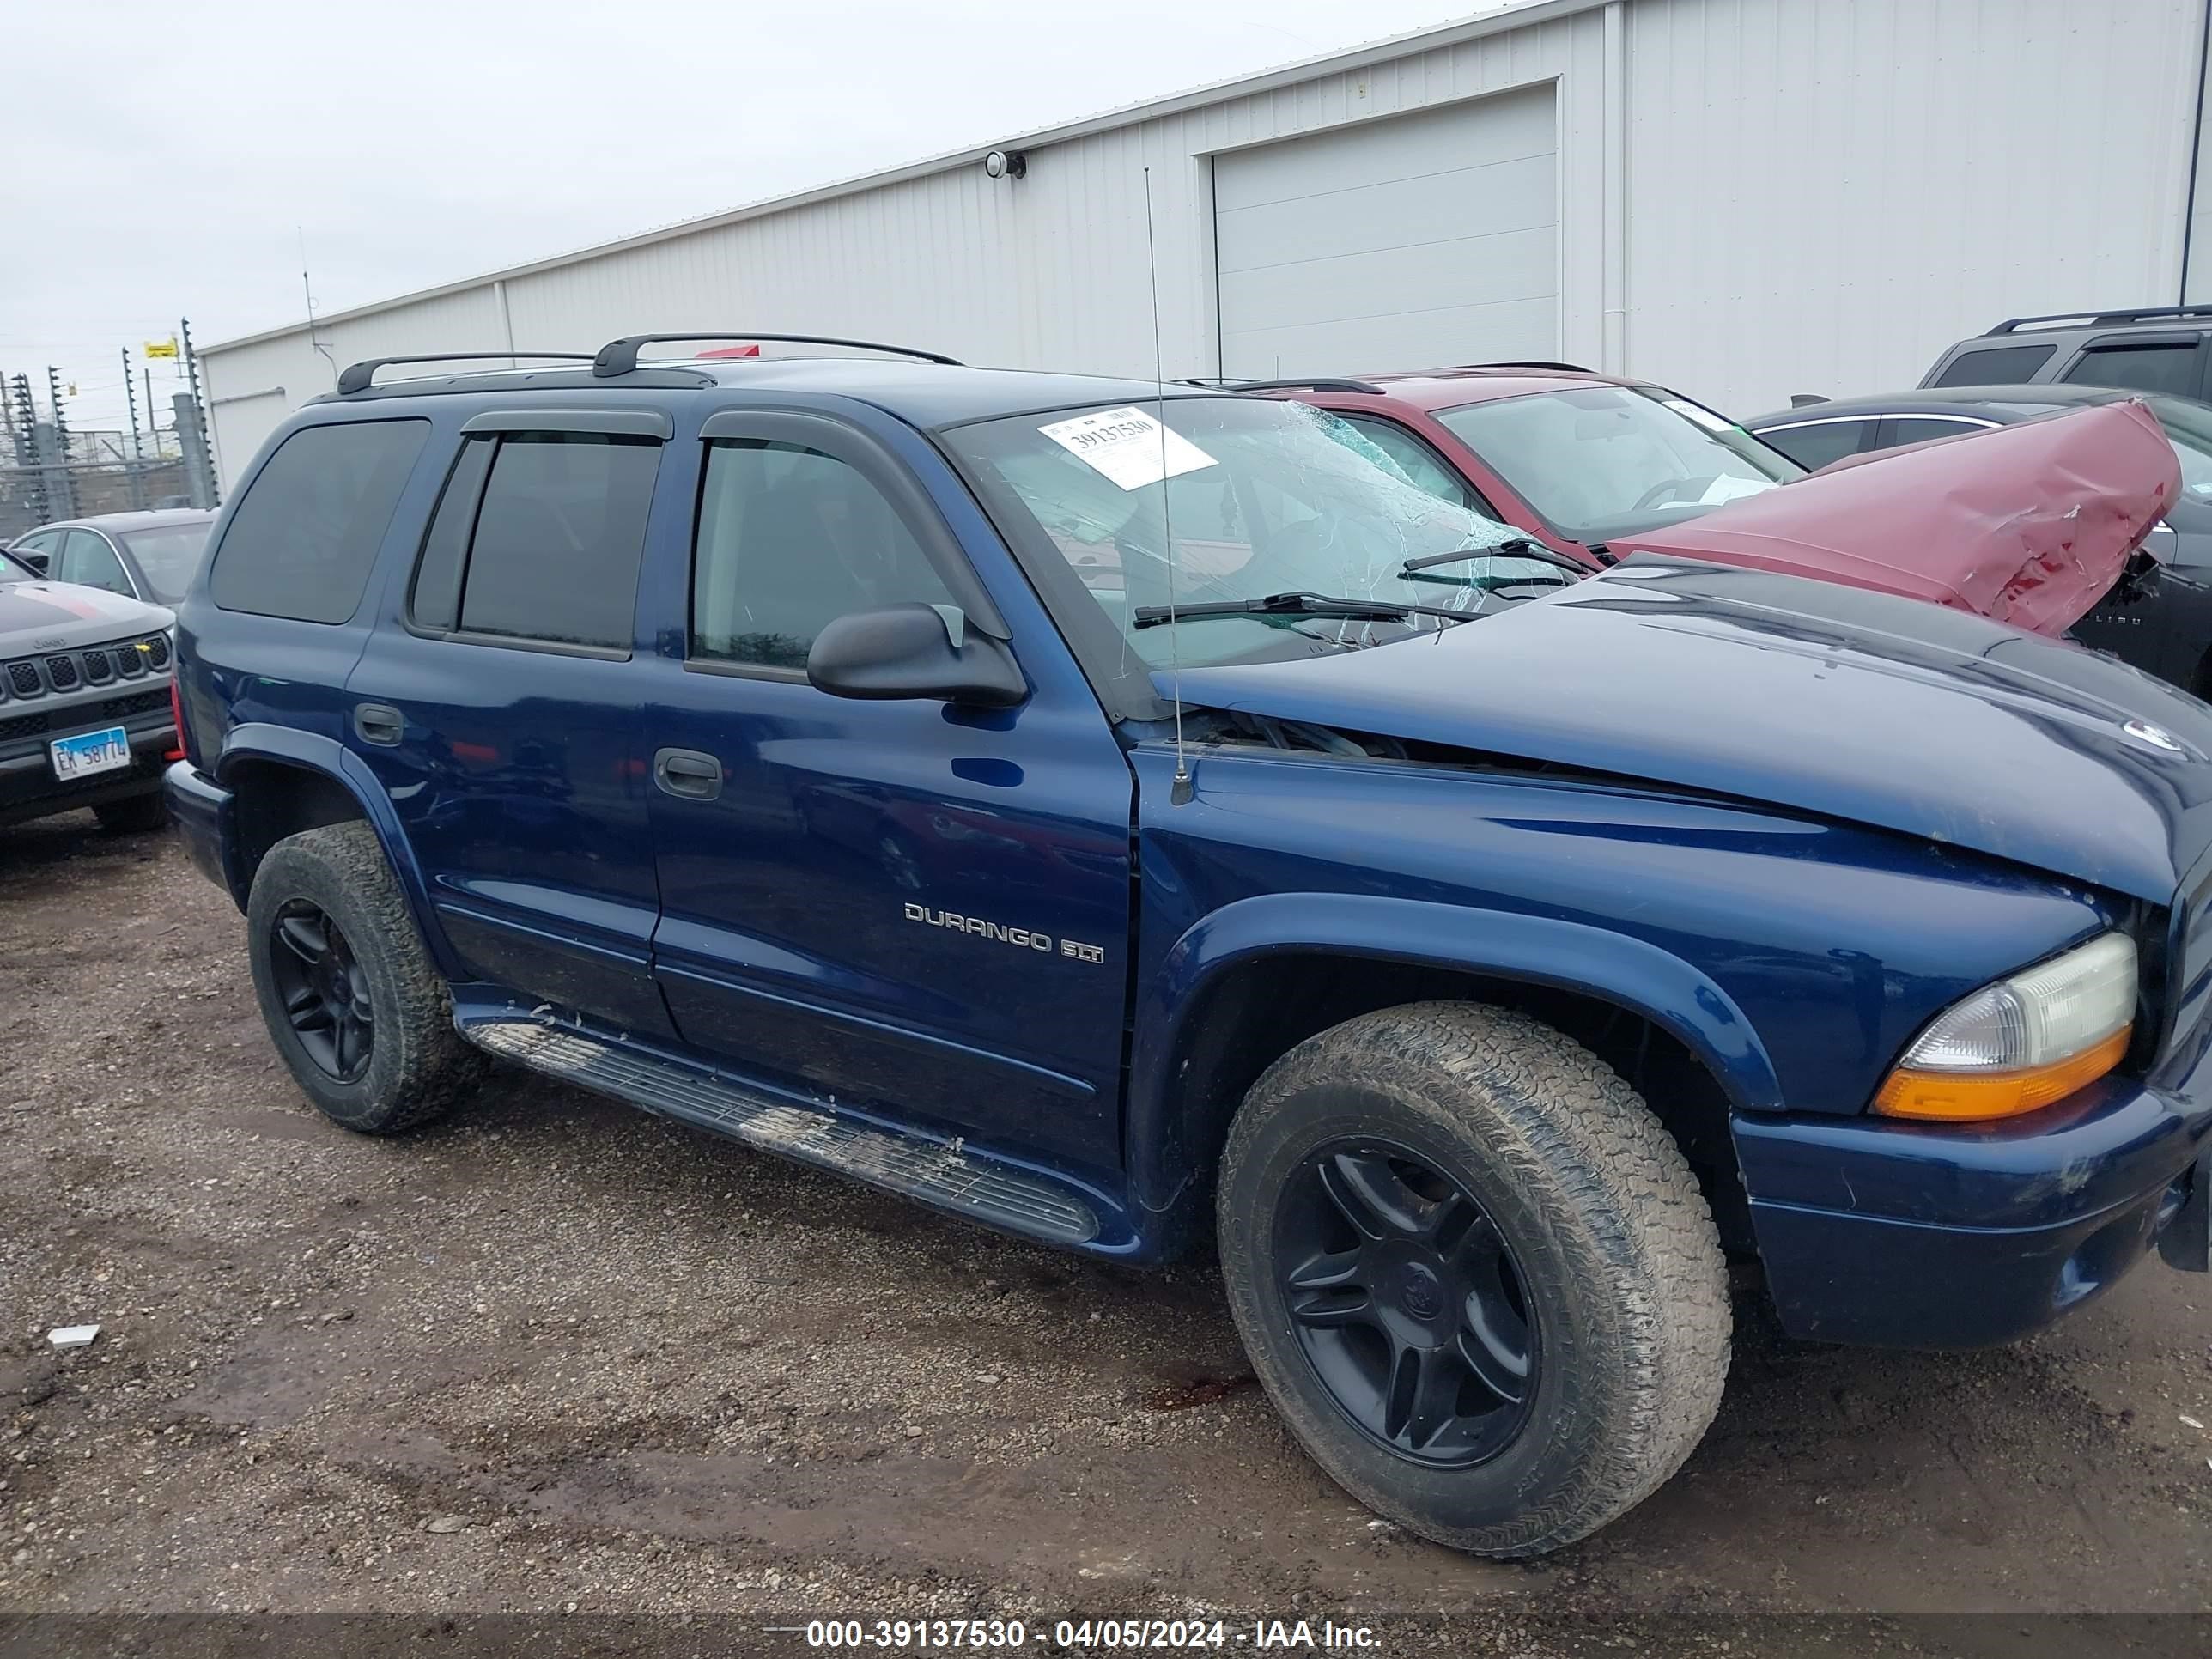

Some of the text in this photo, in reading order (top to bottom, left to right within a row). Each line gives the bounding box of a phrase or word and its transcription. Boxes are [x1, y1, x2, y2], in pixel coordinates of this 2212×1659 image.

[1071, 420, 1154, 449] 39137530
[2082, 614, 2141, 625] LIBU
[33, 637, 66, 649] Jeep
[82, 739, 126, 765] 58774
[904, 902, 1103, 963] DURANGO SLT
